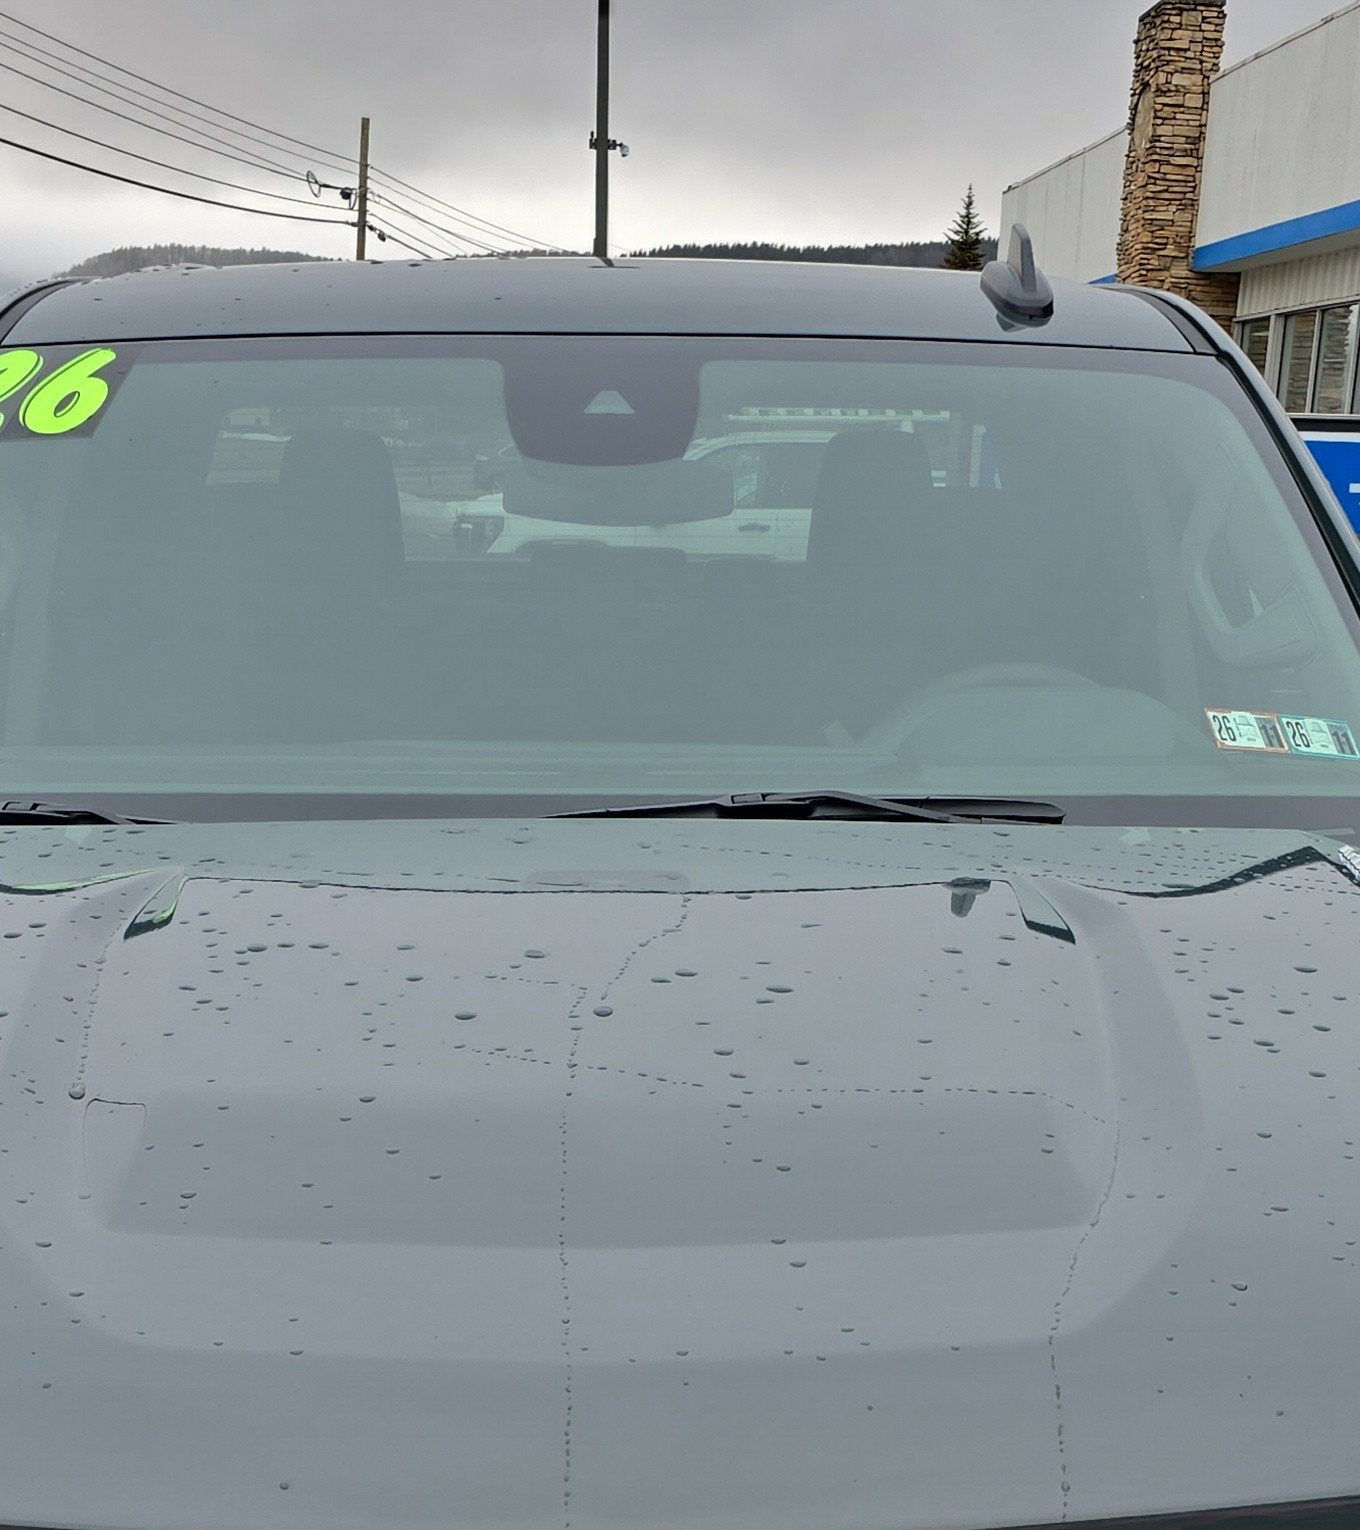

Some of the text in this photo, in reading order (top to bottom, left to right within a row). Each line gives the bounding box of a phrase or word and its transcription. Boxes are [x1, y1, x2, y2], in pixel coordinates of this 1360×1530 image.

[1212, 714, 1286, 749] 26 11
[1285, 720, 1358, 756] 26 11
